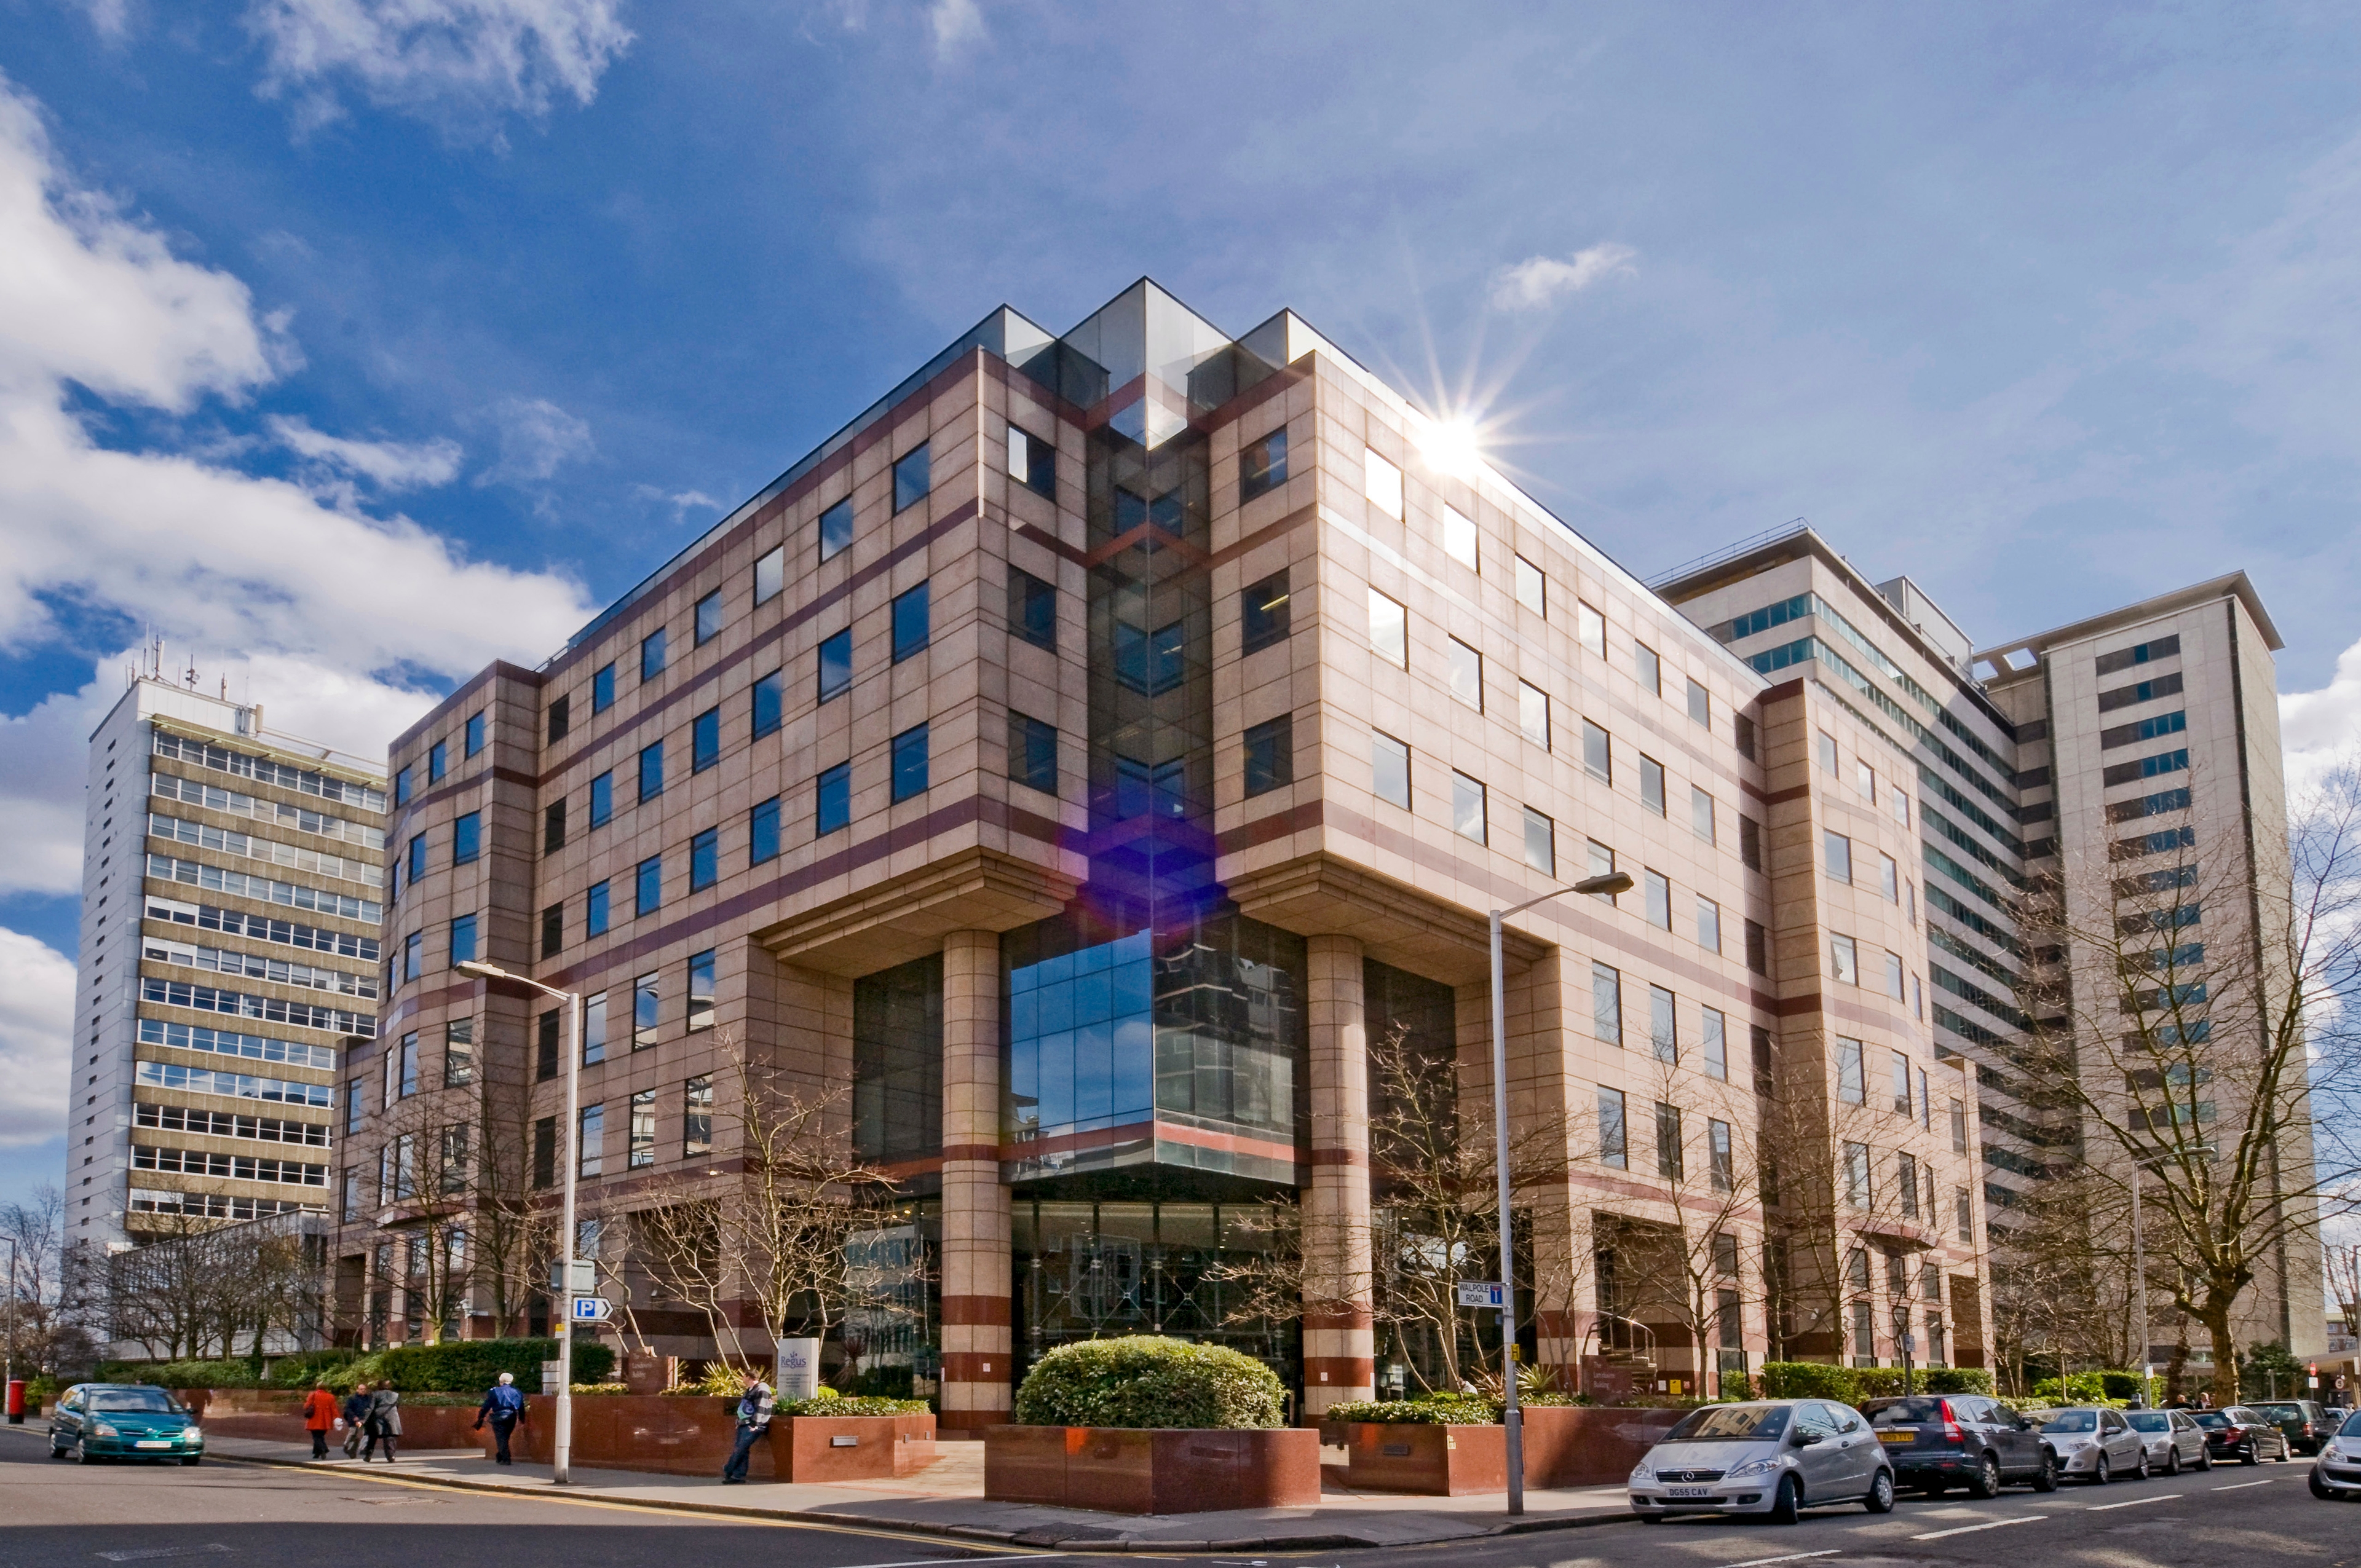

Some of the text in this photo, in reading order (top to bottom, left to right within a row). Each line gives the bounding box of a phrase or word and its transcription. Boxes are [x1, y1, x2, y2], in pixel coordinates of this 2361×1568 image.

[1459, 1283, 1489, 1293] WALPOLE
[1466, 1294, 1483, 1302] ROAD
[581, 1301, 594, 1315] P
[781, 1356, 807, 1369] Regus
